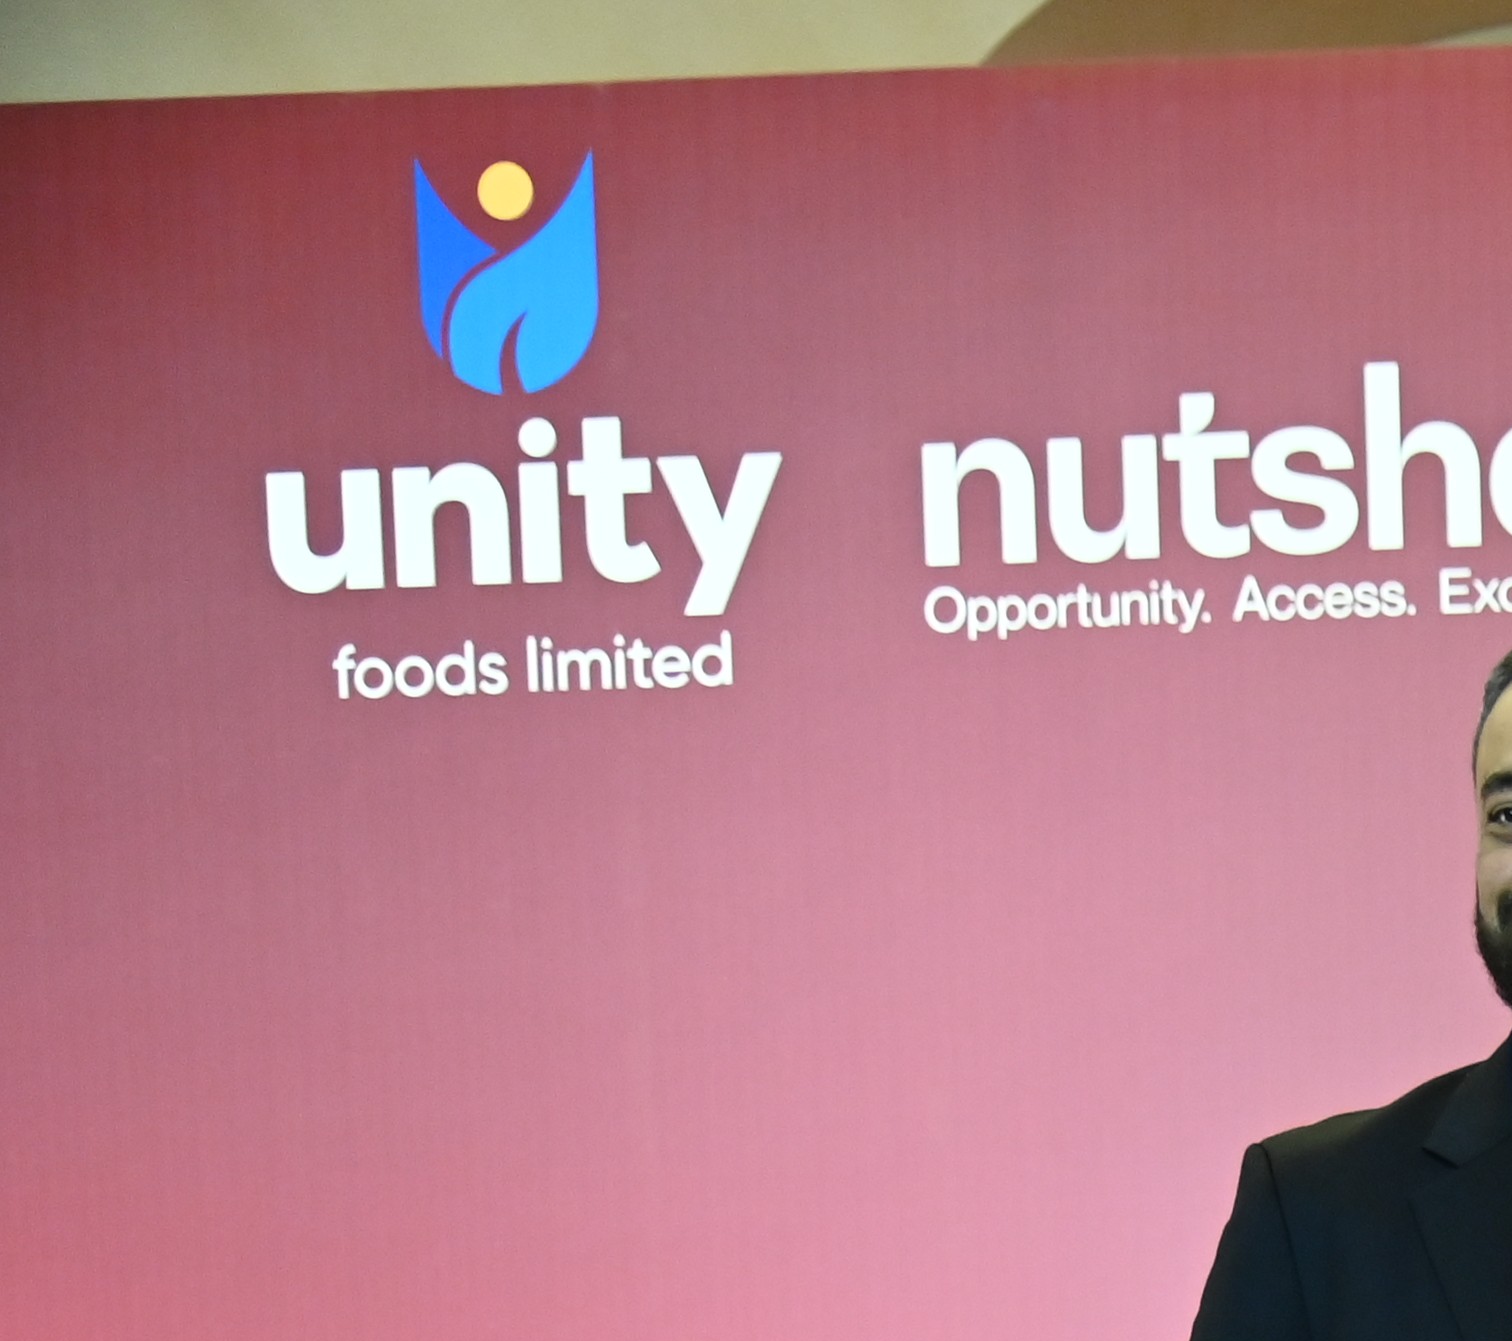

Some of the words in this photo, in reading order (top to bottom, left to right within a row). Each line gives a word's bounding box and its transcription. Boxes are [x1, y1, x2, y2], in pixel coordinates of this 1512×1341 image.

[266, 417, 782, 616] unity
[924, 579, 1211, 641] Opportunity.
[1233, 575, 1416, 622] Access.
[333, 640, 508, 699] foods
[527, 630, 733, 692] limited
